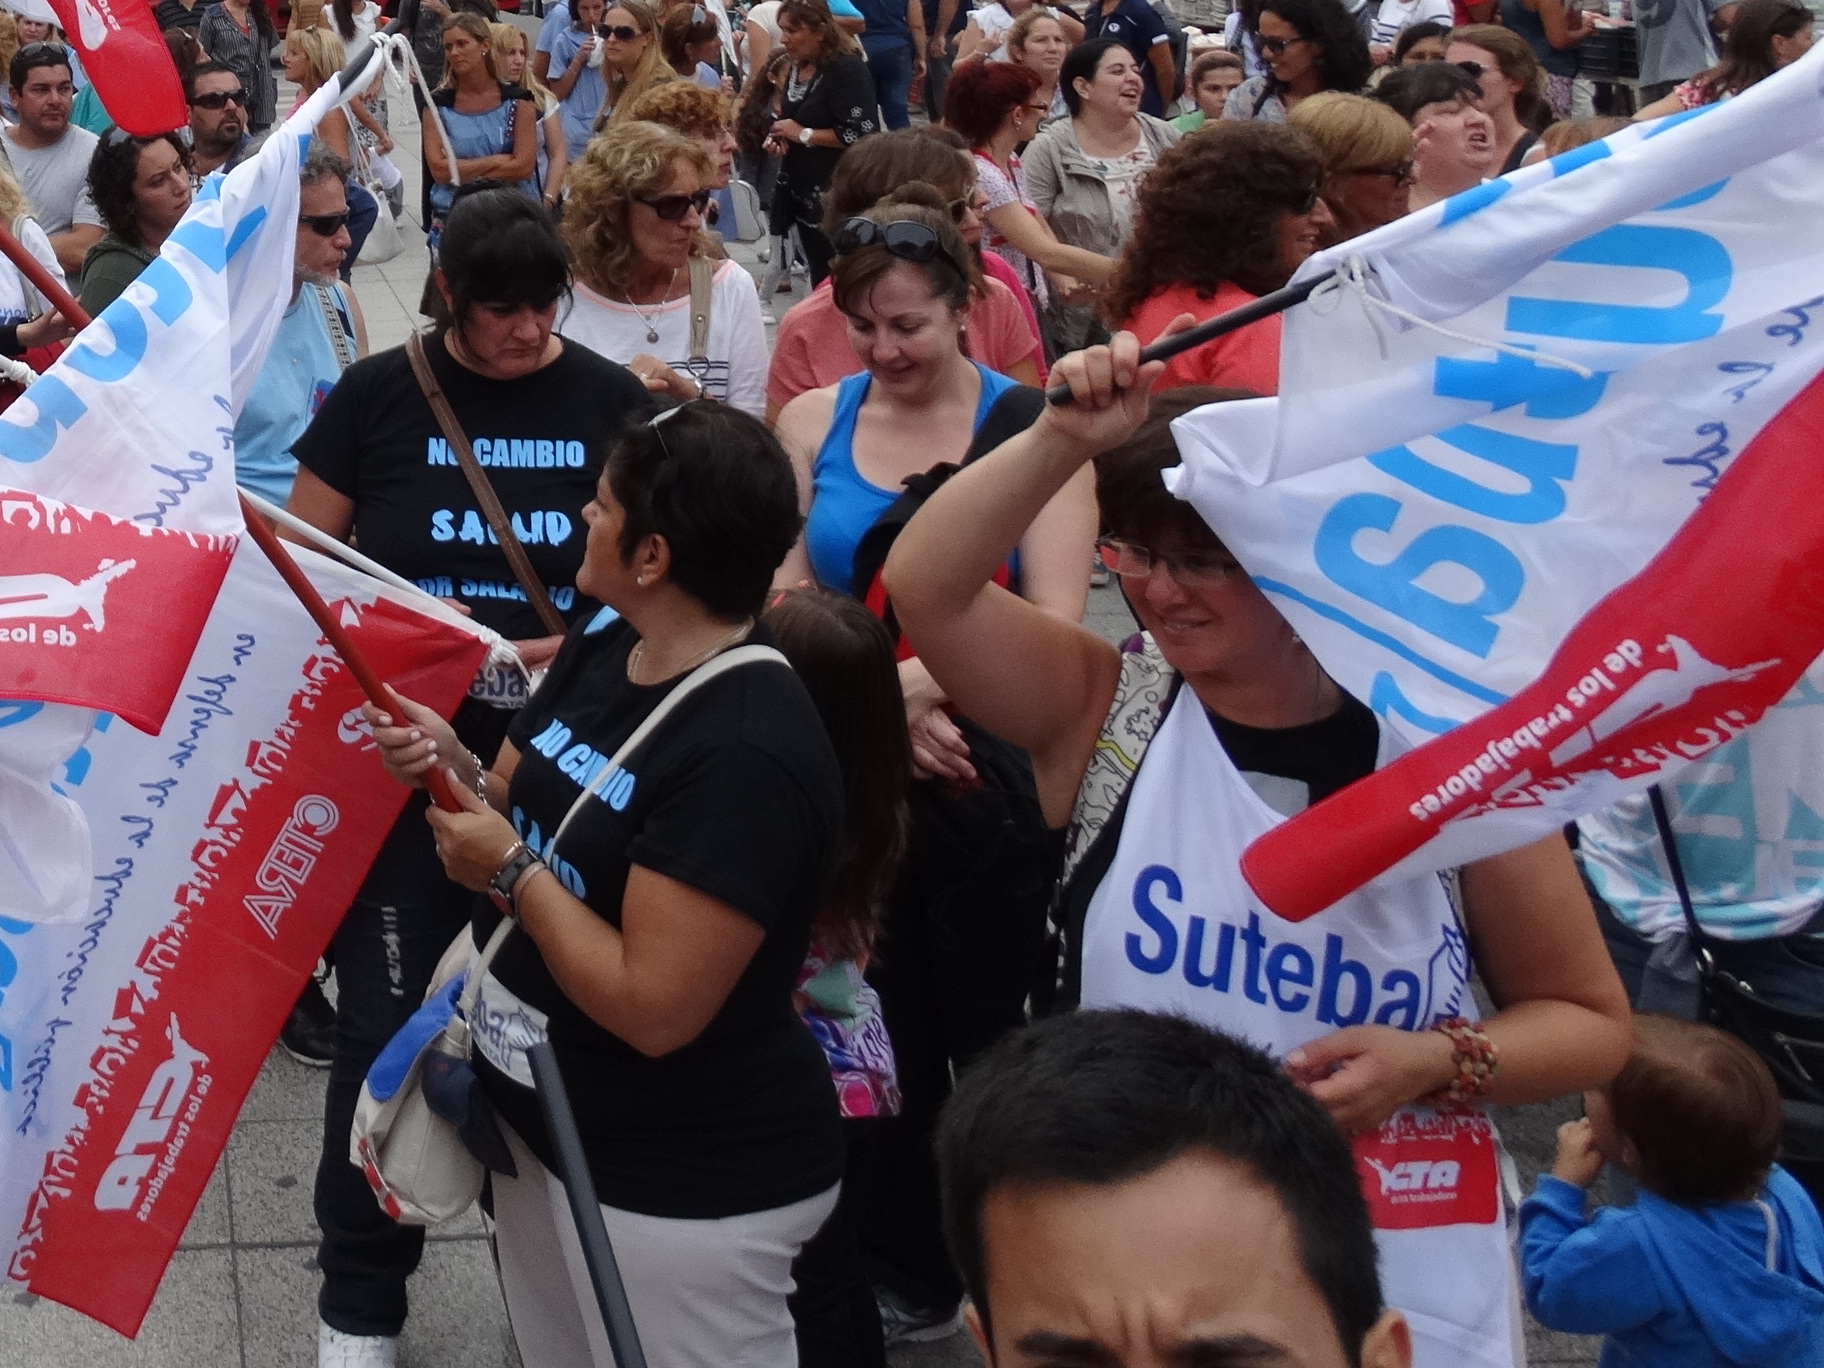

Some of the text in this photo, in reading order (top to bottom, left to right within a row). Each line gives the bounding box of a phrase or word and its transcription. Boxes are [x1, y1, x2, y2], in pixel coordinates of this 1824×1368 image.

[473, 437, 585, 468] CAMBIO
[413, 576, 575, 611] OR SALAIO
[1602, 638, 1643, 673] de
[1567, 666, 1617, 708] los
[1408, 702, 1574, 821] trabajadores
[1124, 864, 1422, 1032] Suteba
